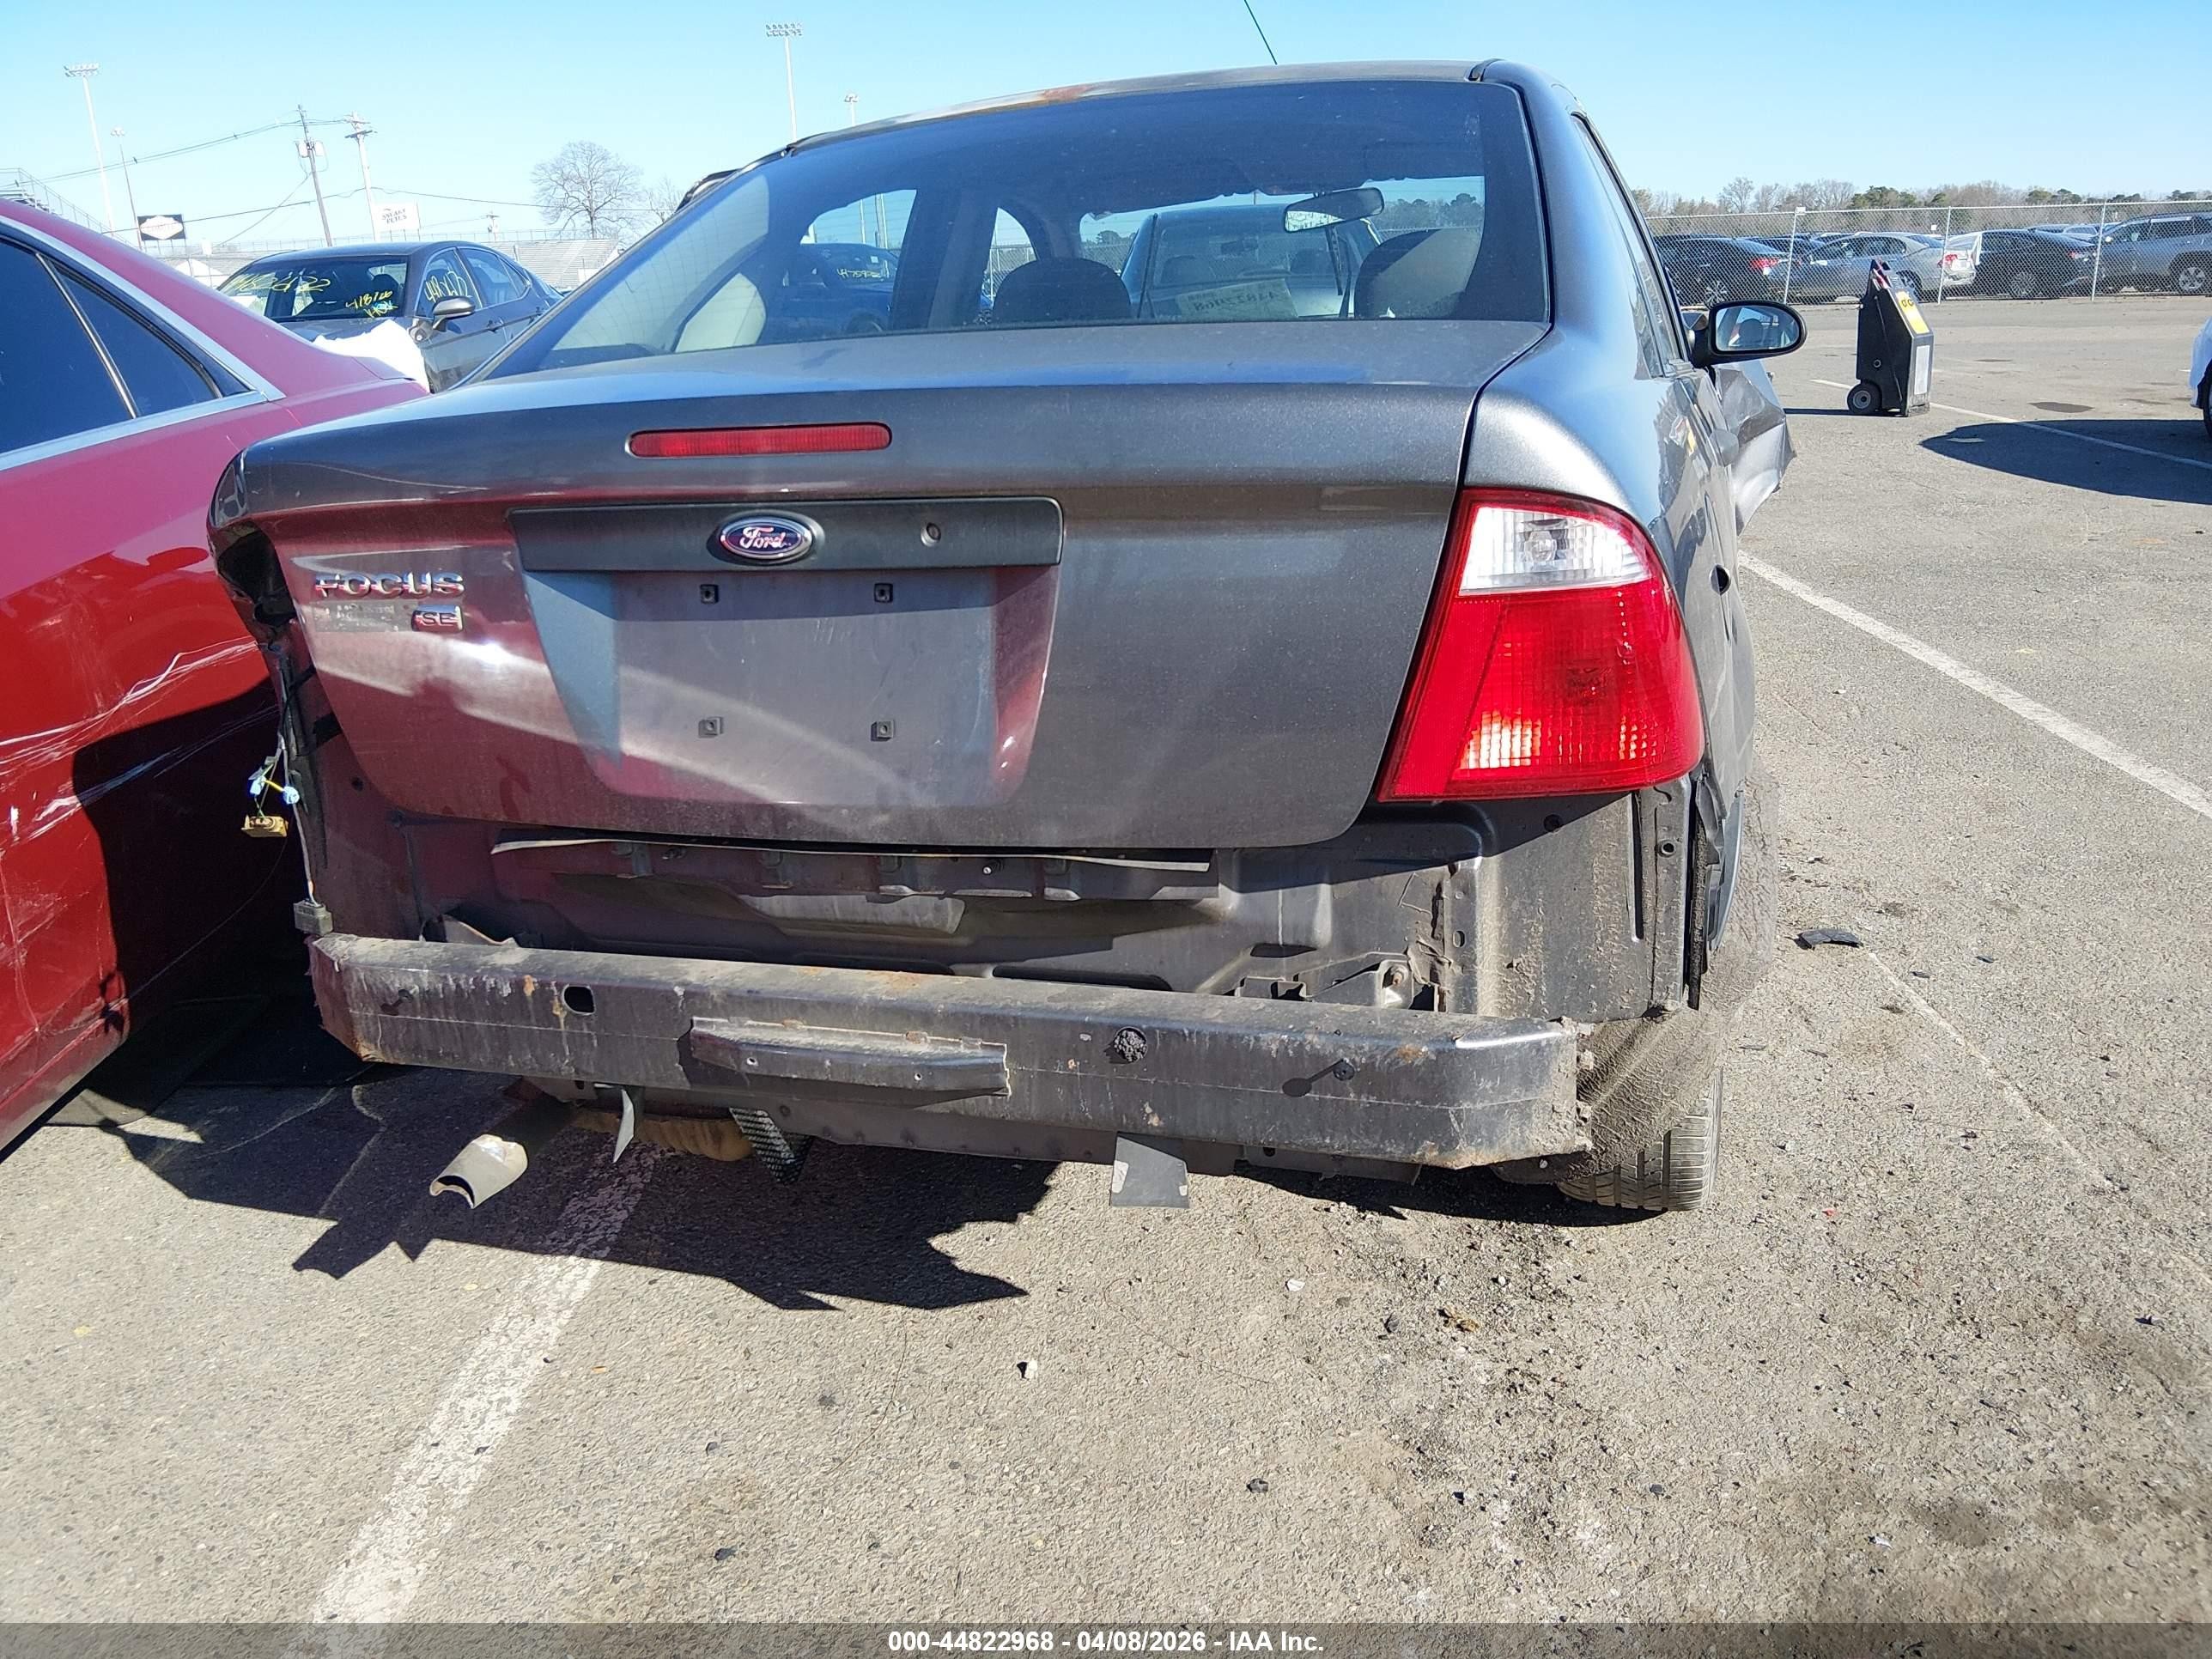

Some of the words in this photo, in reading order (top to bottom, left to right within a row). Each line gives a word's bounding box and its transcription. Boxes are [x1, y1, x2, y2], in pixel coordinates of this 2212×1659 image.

[739, 526, 791, 549] Ford
[314, 571, 465, 599] FOCUS
[421, 611, 456, 627] SE
